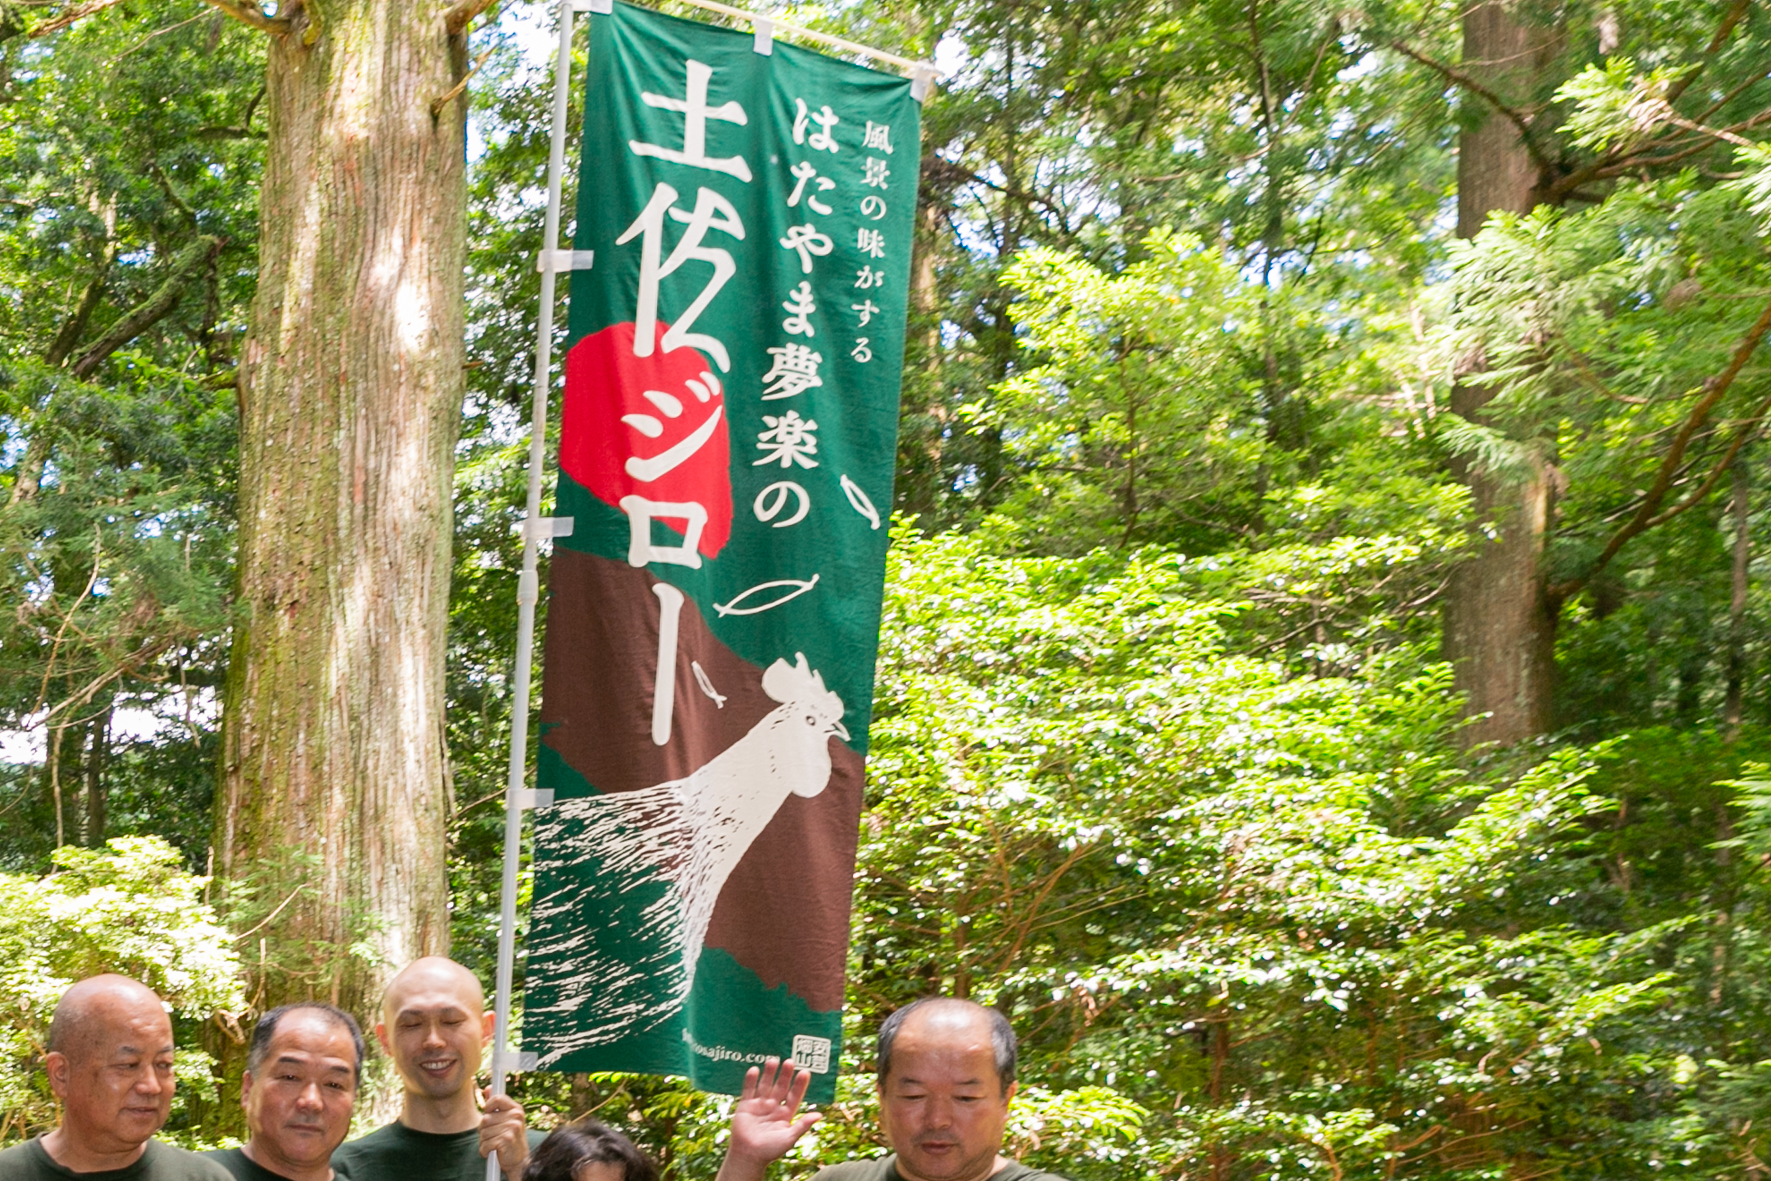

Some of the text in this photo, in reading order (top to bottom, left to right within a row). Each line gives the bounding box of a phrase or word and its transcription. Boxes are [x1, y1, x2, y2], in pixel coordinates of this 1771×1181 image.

[616, 59, 753, 747] 土佐ジロー
[751, 98, 840, 529] はたやま夢楽の
[850, 119, 895, 364] 風景の味がする
